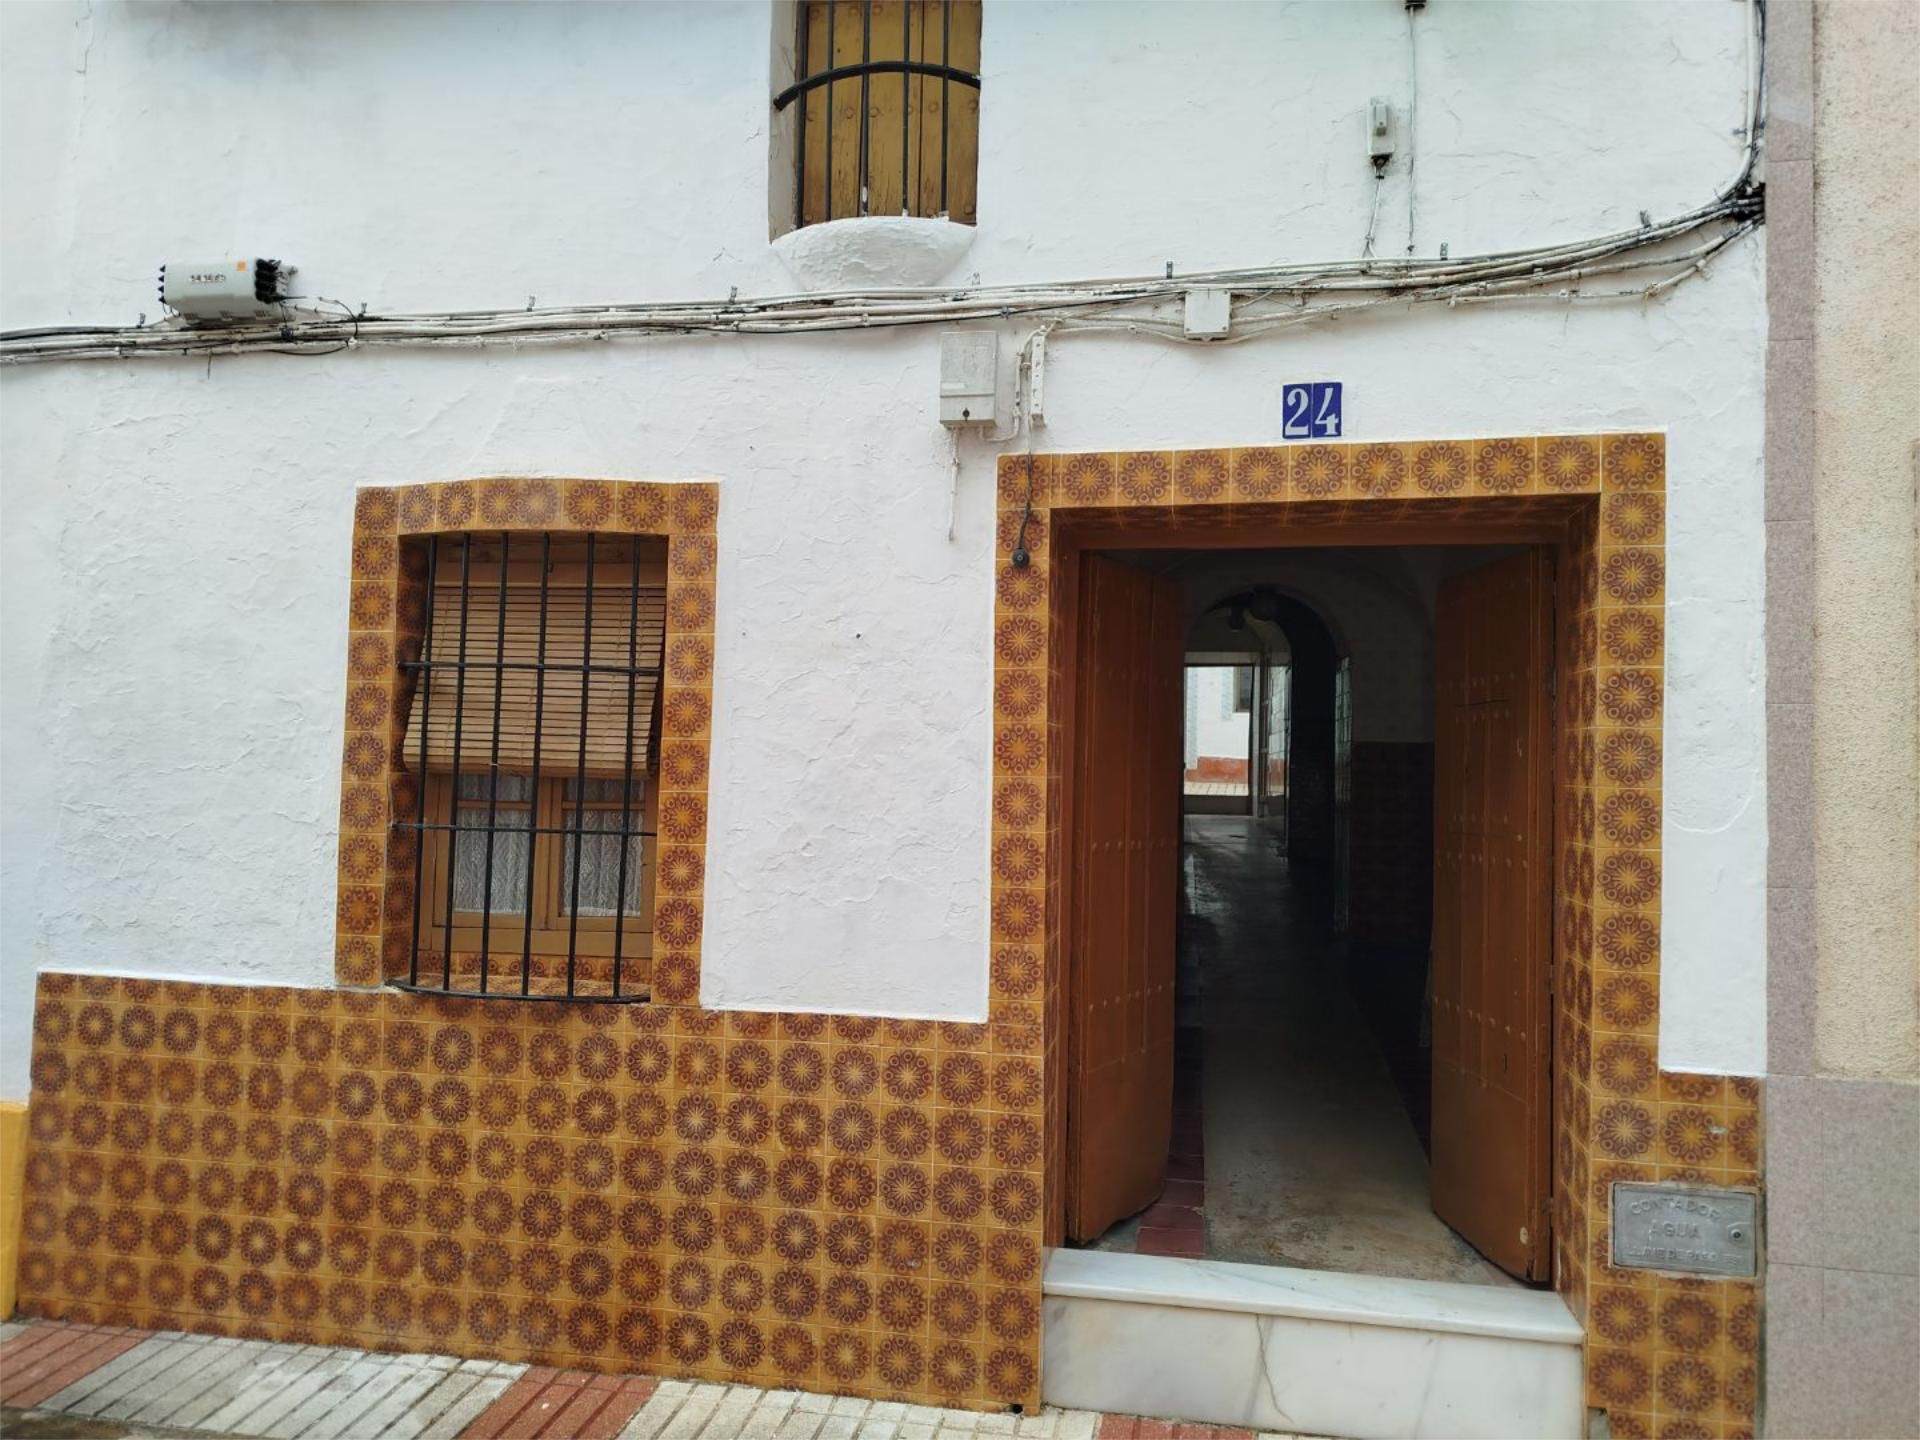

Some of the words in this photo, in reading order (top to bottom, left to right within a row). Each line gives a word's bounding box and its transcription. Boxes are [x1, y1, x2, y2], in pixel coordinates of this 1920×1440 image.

[1285, 387, 1339, 436] 24
[1631, 1198, 1721, 1221] CONTADOR
[1649, 1220, 1702, 1240] AGUA
